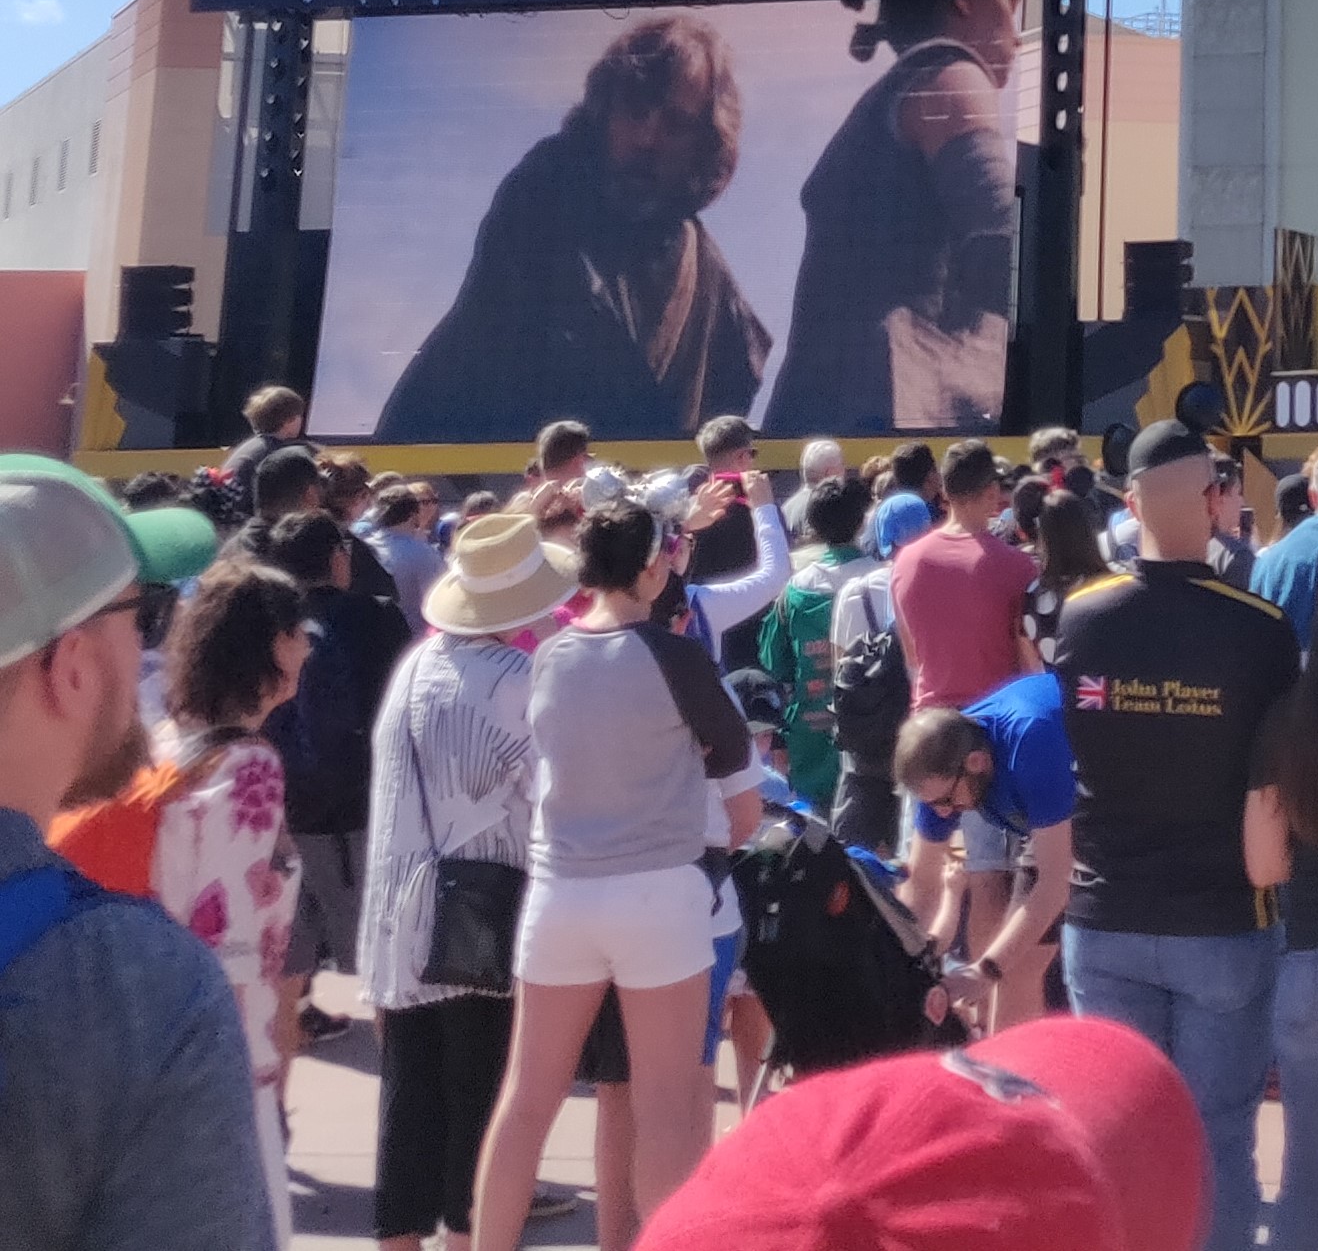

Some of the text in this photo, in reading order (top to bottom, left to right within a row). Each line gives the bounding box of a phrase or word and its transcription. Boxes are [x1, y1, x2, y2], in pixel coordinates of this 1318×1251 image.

[1112, 679, 1221, 699] John Player
[1113, 696, 1223, 716] Team Lotus
